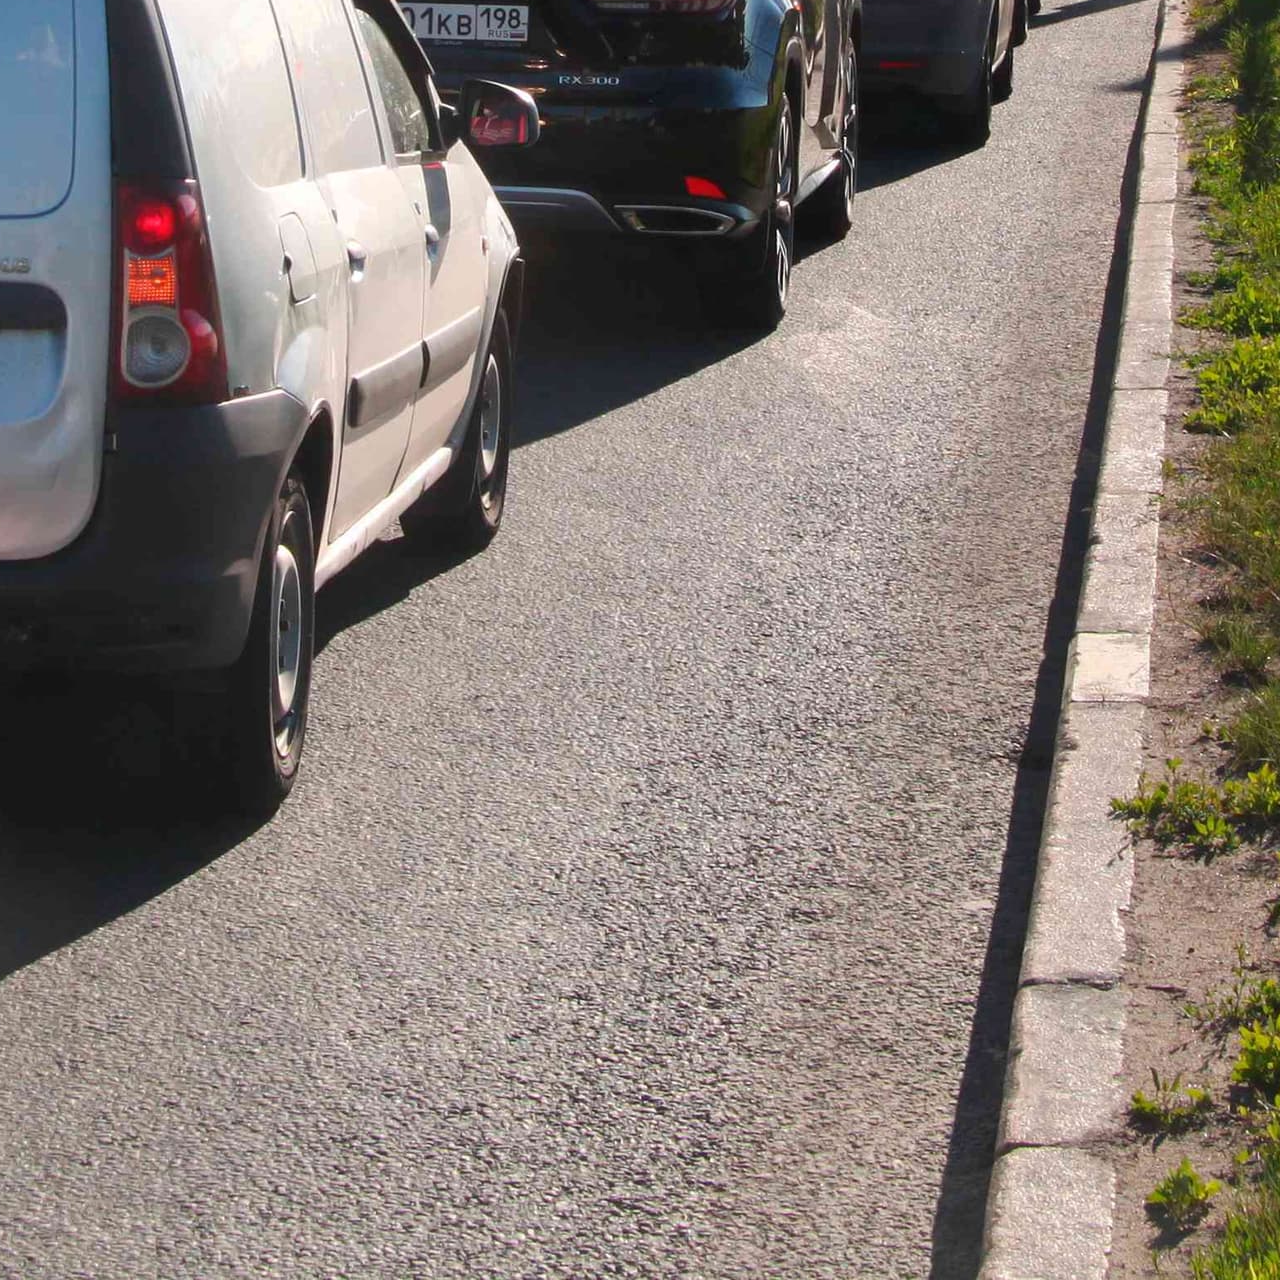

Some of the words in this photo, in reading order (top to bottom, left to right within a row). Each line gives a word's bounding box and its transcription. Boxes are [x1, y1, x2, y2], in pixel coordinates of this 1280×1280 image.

[480, 7, 521, 29] 198
[487, 29, 510, 39] RUS
[559, 75, 582, 86] RX
[583, 76, 620, 86] 300
